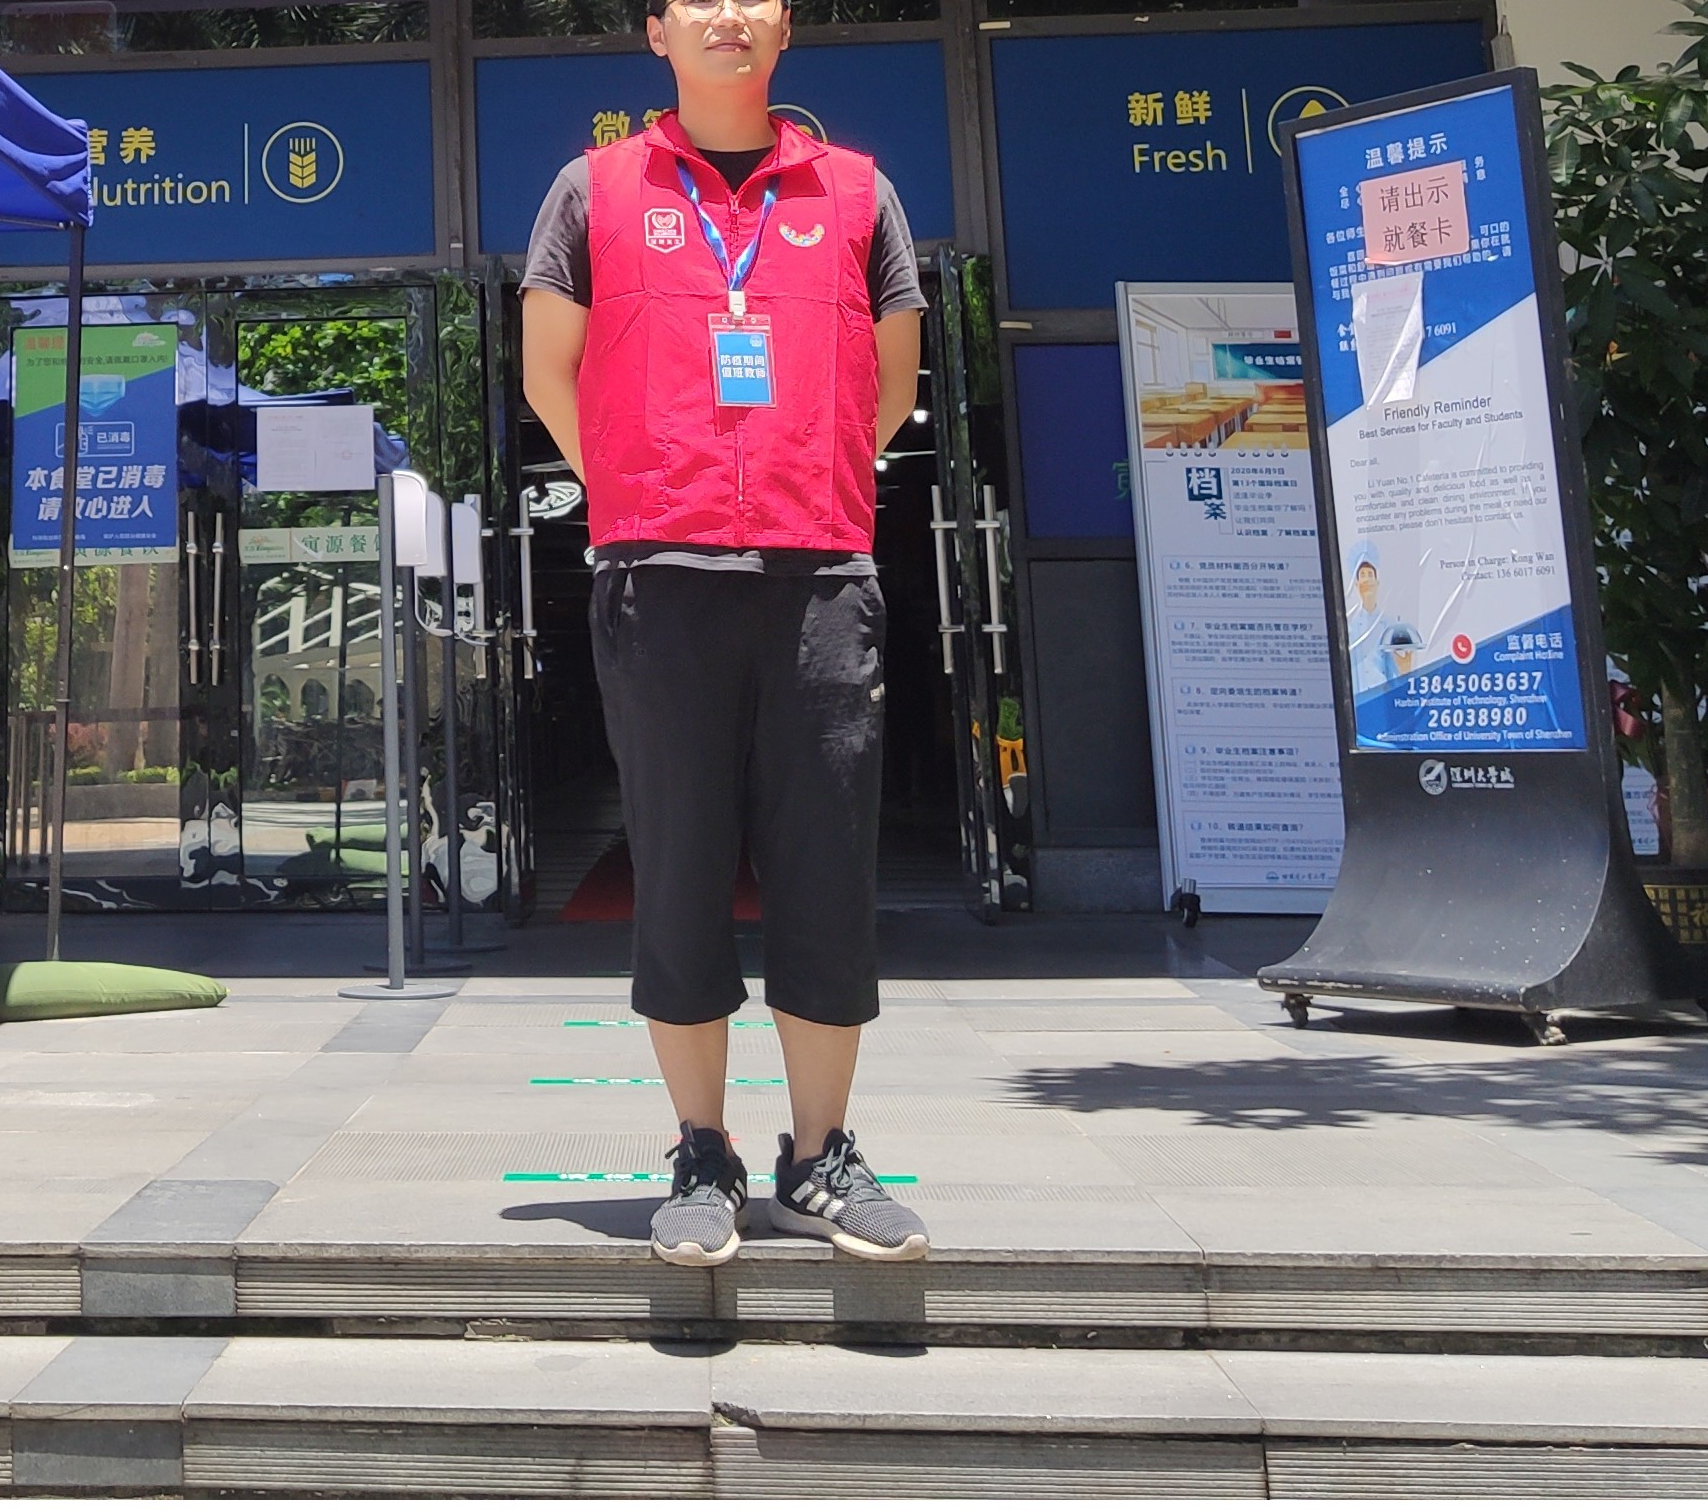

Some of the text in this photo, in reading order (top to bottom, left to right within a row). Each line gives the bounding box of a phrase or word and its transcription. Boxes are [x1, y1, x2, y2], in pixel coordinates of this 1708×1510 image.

[1128, 89, 1213, 127] 新鲜
[90, 125, 155, 166] 营养
[1365, 133, 1447, 169] 温馨提示
[1133, 141, 1227, 173] Fresh
[1379, 176, 1449, 214] 请出示
[1383, 217, 1453, 253] 就餐卡
[1384, 396, 1491, 420] Friendly Reminder
[1359, 410, 1523, 439] Best Services for Faculty and Students
[97, 432, 130, 443] 已消毒
[1350, 458, 1367, 468] Dear
[1509, 461, 1544, 474] providing
[25, 465, 166, 490] 本食堂已消毒
[1511, 553, 1533, 566] Kong
[1535, 552, 1554, 562] Wan
[1496, 568, 1511, 578] 136
[1513, 567, 1534, 577] 6017
[1536, 566, 1555, 576] 6091
[1507, 632, 1562, 650] 监督电话
[1494, 652, 1564, 662] Complaint Hotline
[1407, 672, 1543, 694] 13845063637
[1428, 707, 1528, 727] 26038980
[1430, 731, 1452, 741] Office
